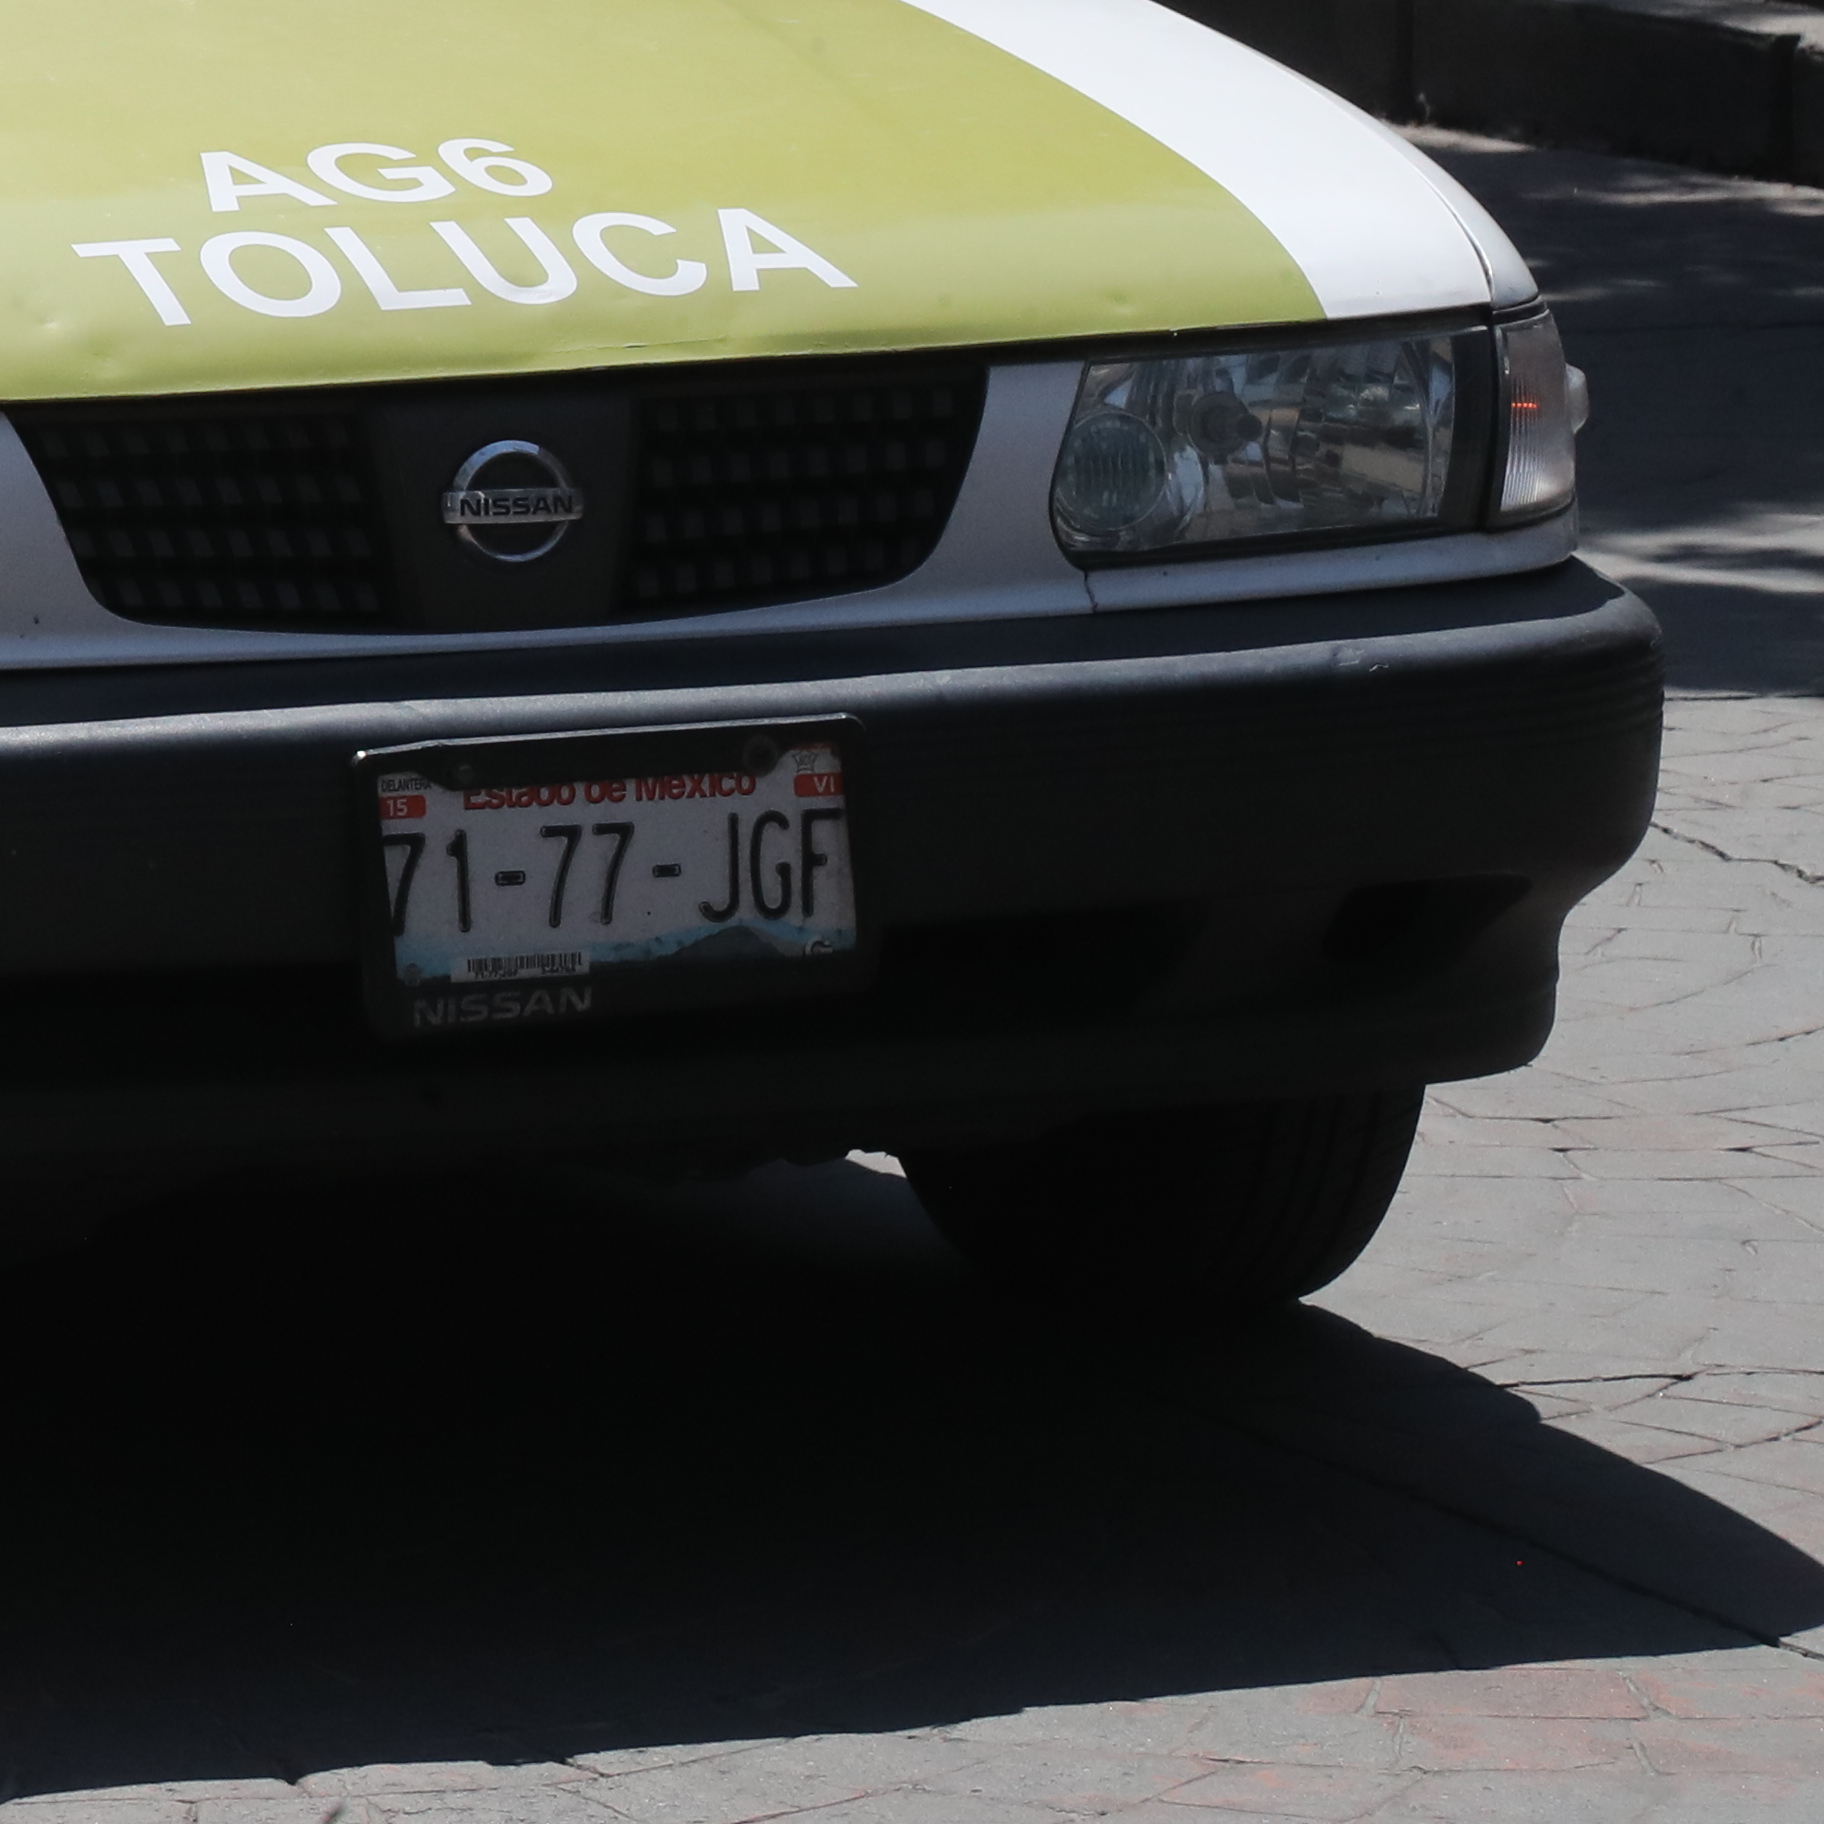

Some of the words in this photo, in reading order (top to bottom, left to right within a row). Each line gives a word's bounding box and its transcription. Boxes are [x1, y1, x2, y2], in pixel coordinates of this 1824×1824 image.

[199, 138, 552, 212] AG6
[71, 206, 859, 326] TOLUCA
[460, 495, 574, 517] NISSAN
[380, 777, 432, 793] DELANTERA
[463, 782, 576, 811] Estado
[813, 776, 837, 794] VI
[386, 798, 408, 816] 15
[382, 806, 845, 936] 71-77-JGF
[414, 986, 593, 1028] NISSAN
